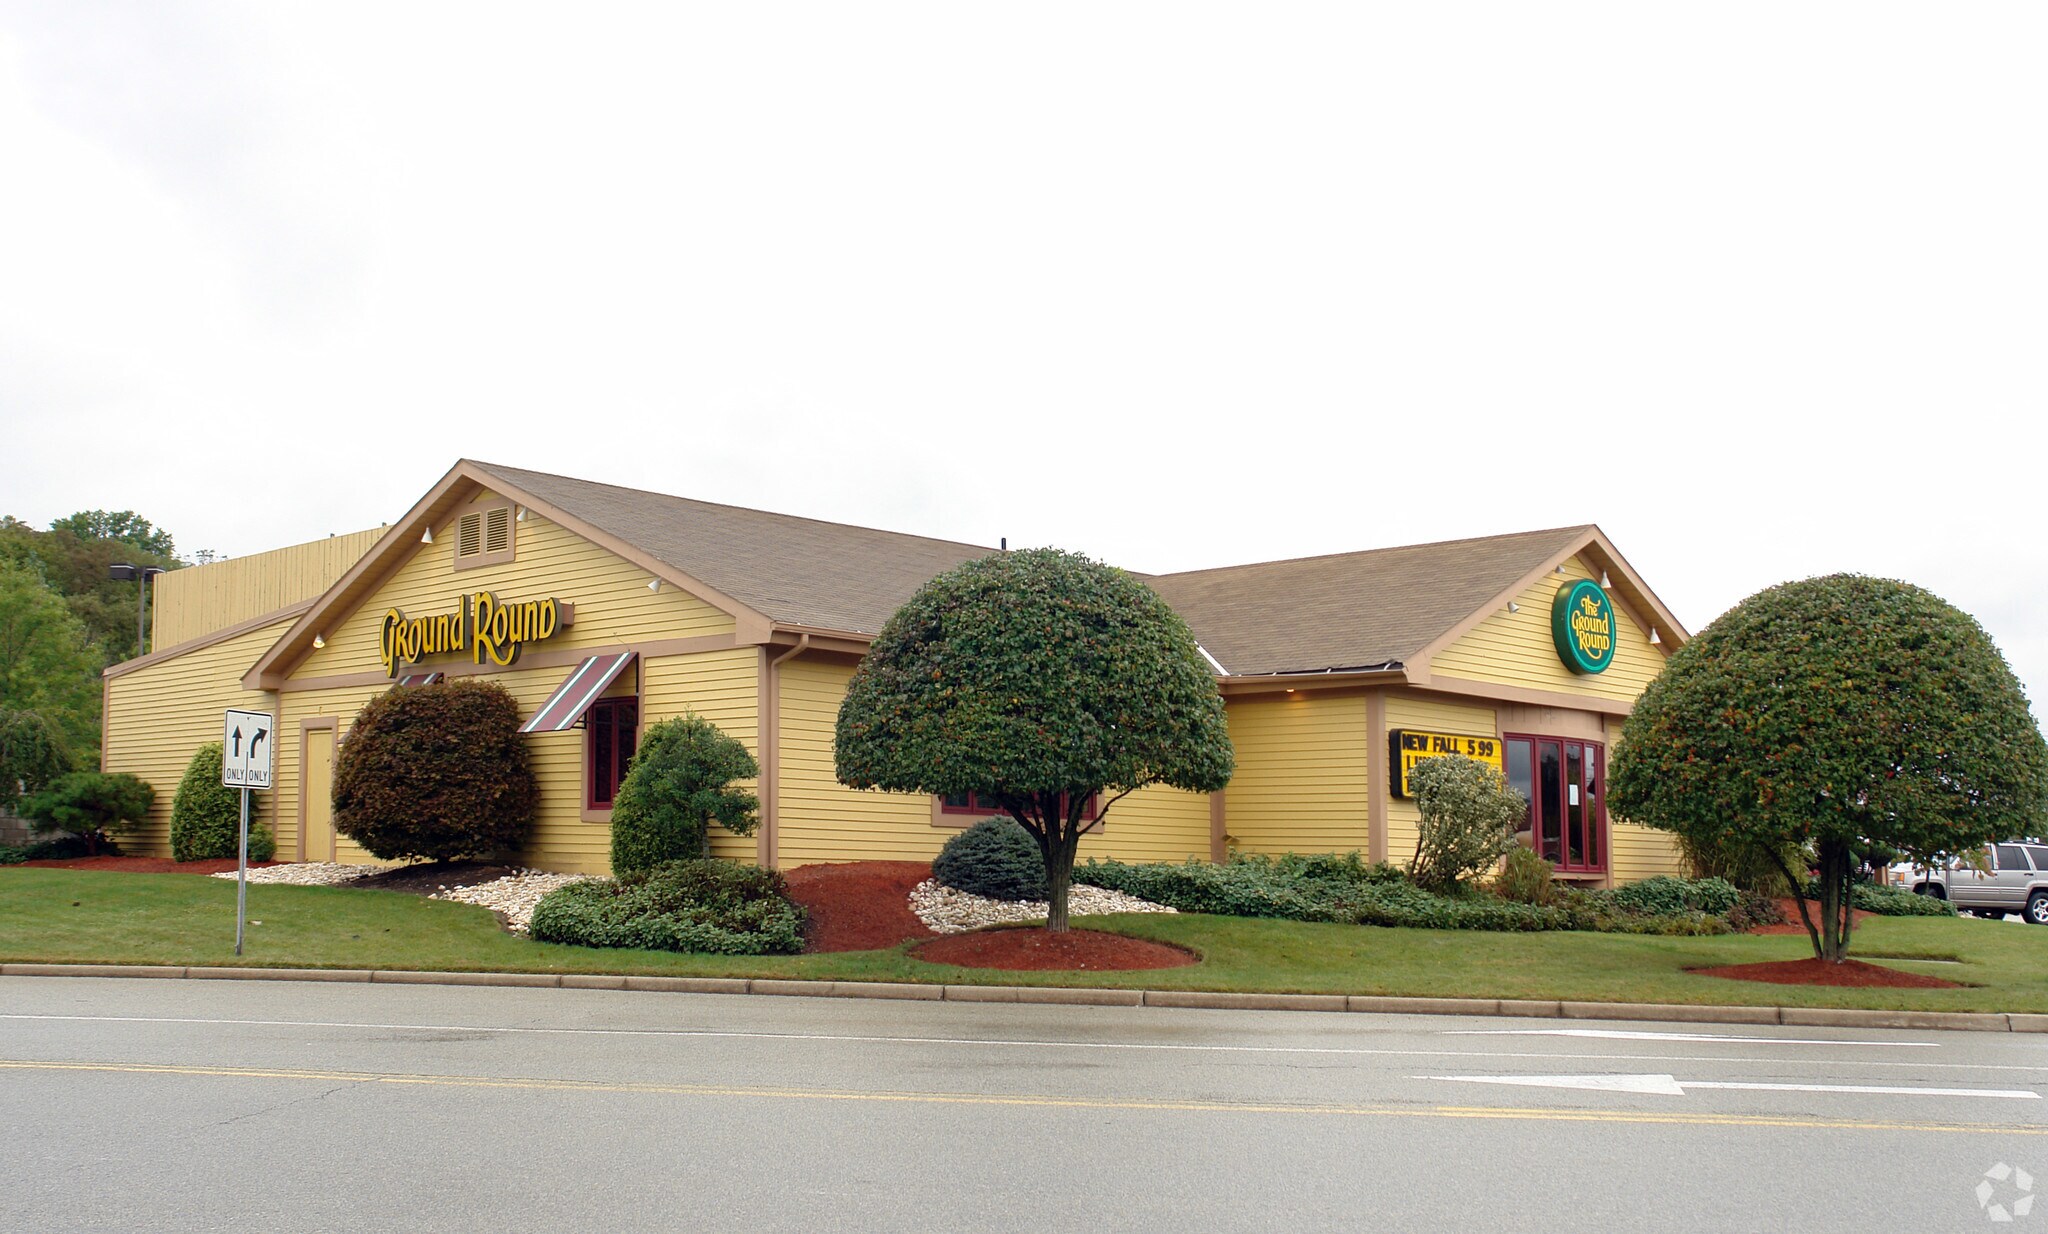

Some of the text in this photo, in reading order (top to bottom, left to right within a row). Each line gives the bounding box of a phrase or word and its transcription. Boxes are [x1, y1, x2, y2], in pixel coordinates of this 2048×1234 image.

[1581, 594, 1601, 616] The
[1402, 733, 1429, 752] NEW
[1433, 736, 1460, 754] FALL
[226, 768, 245, 780] ONLY
[248, 769, 268, 782] ONLY
